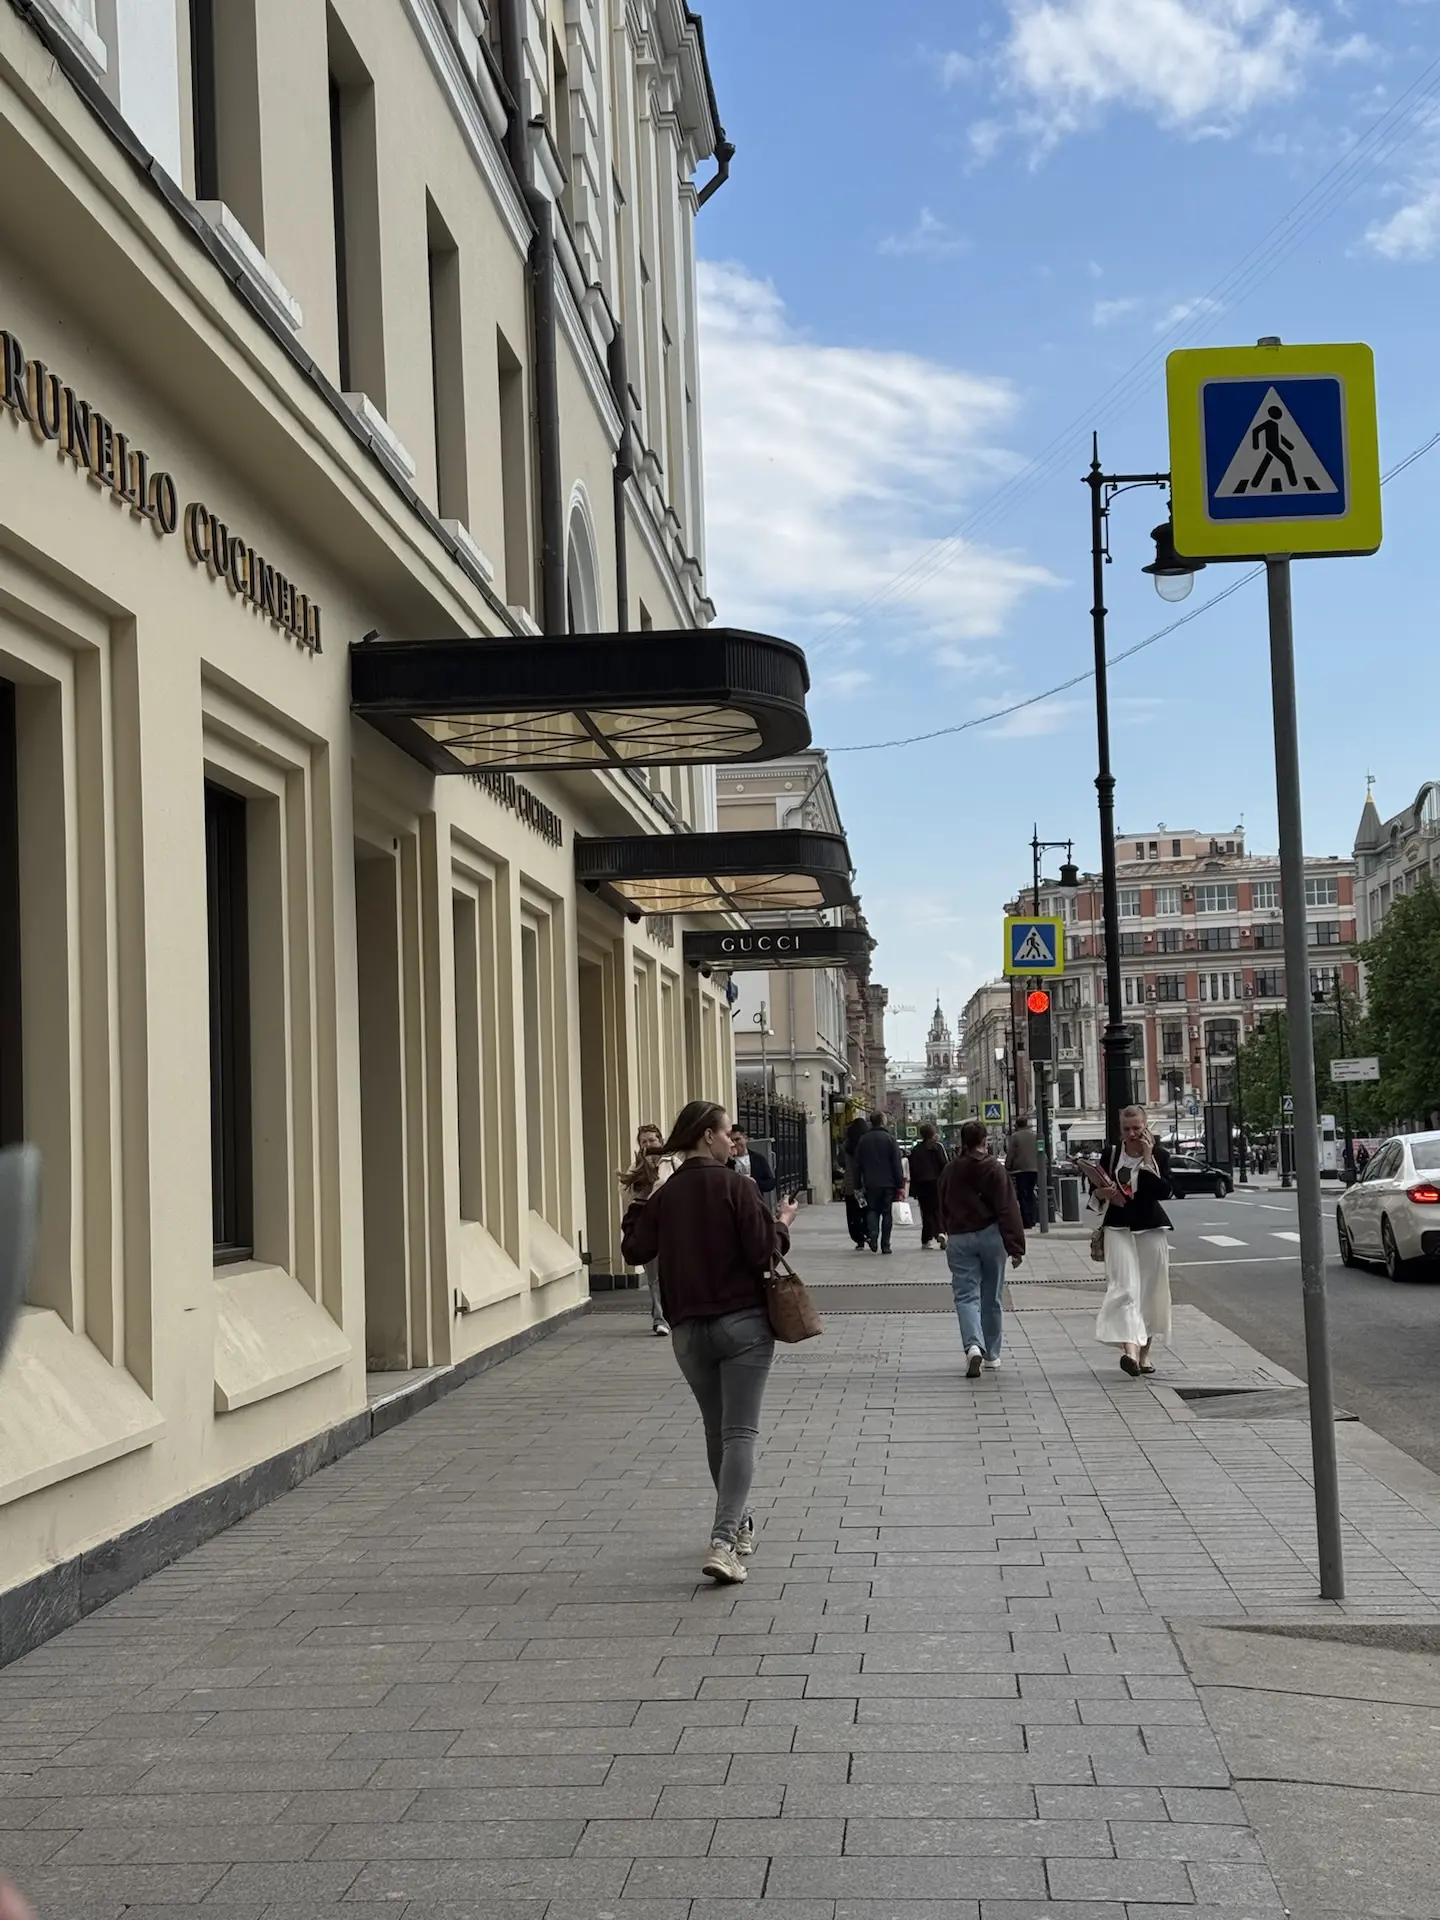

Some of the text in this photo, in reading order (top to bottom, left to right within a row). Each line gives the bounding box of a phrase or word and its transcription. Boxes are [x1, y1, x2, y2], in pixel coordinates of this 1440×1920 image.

[185, 502, 323, 654] CUCINELLI
[515, 784, 563, 847] CUCINELLI
[721, 936, 799, 952] GUCCI
